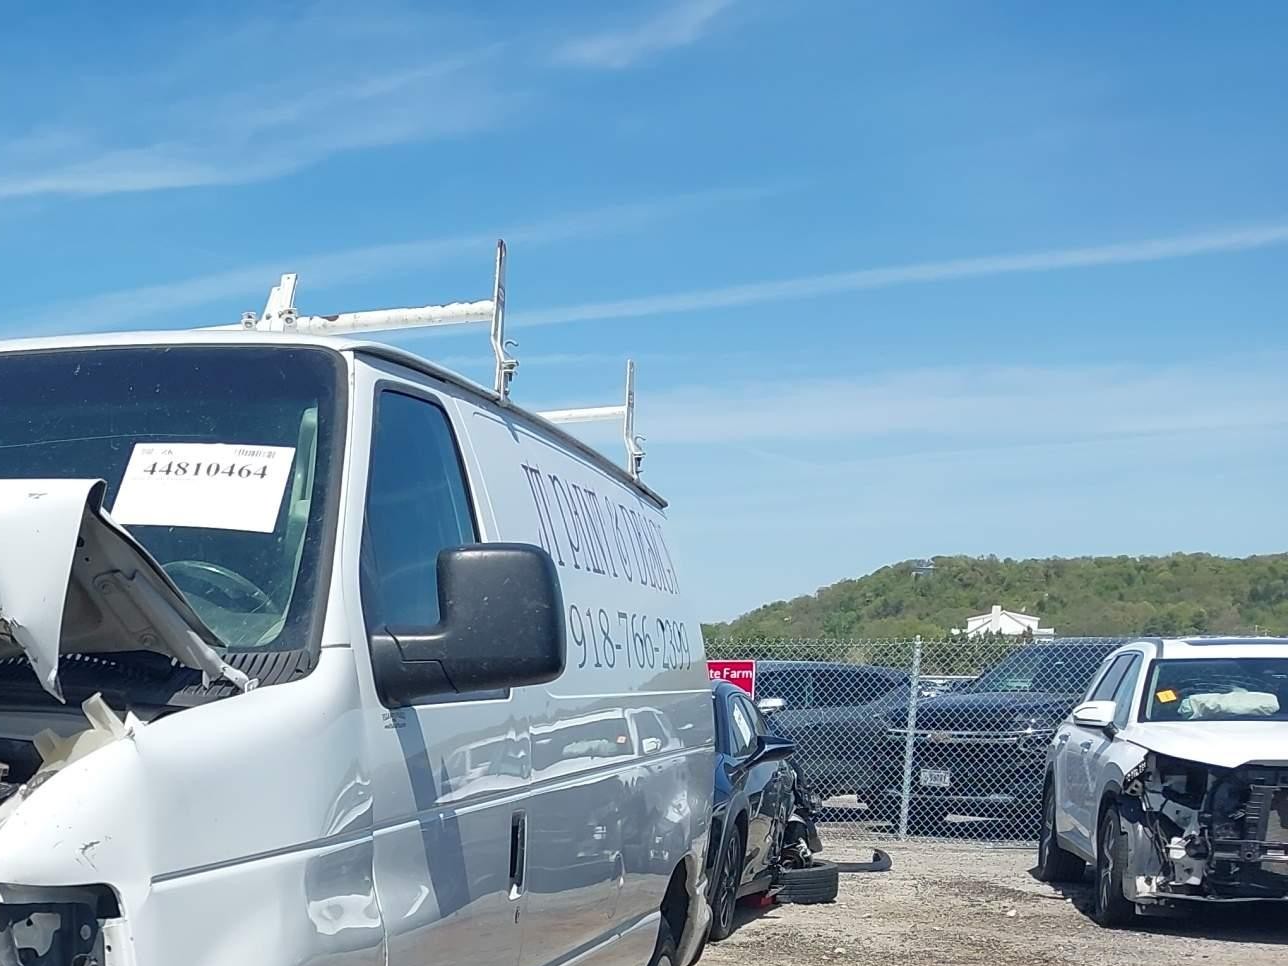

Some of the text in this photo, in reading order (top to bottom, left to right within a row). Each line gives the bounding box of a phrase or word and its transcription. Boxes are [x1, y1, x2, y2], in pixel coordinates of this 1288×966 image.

[143, 461, 268, 479] 44810464
[547, 474, 618, 578] PAINT
[569, 604, 691, 670] 918-766-2399
[723, 667, 753, 679] Farm
